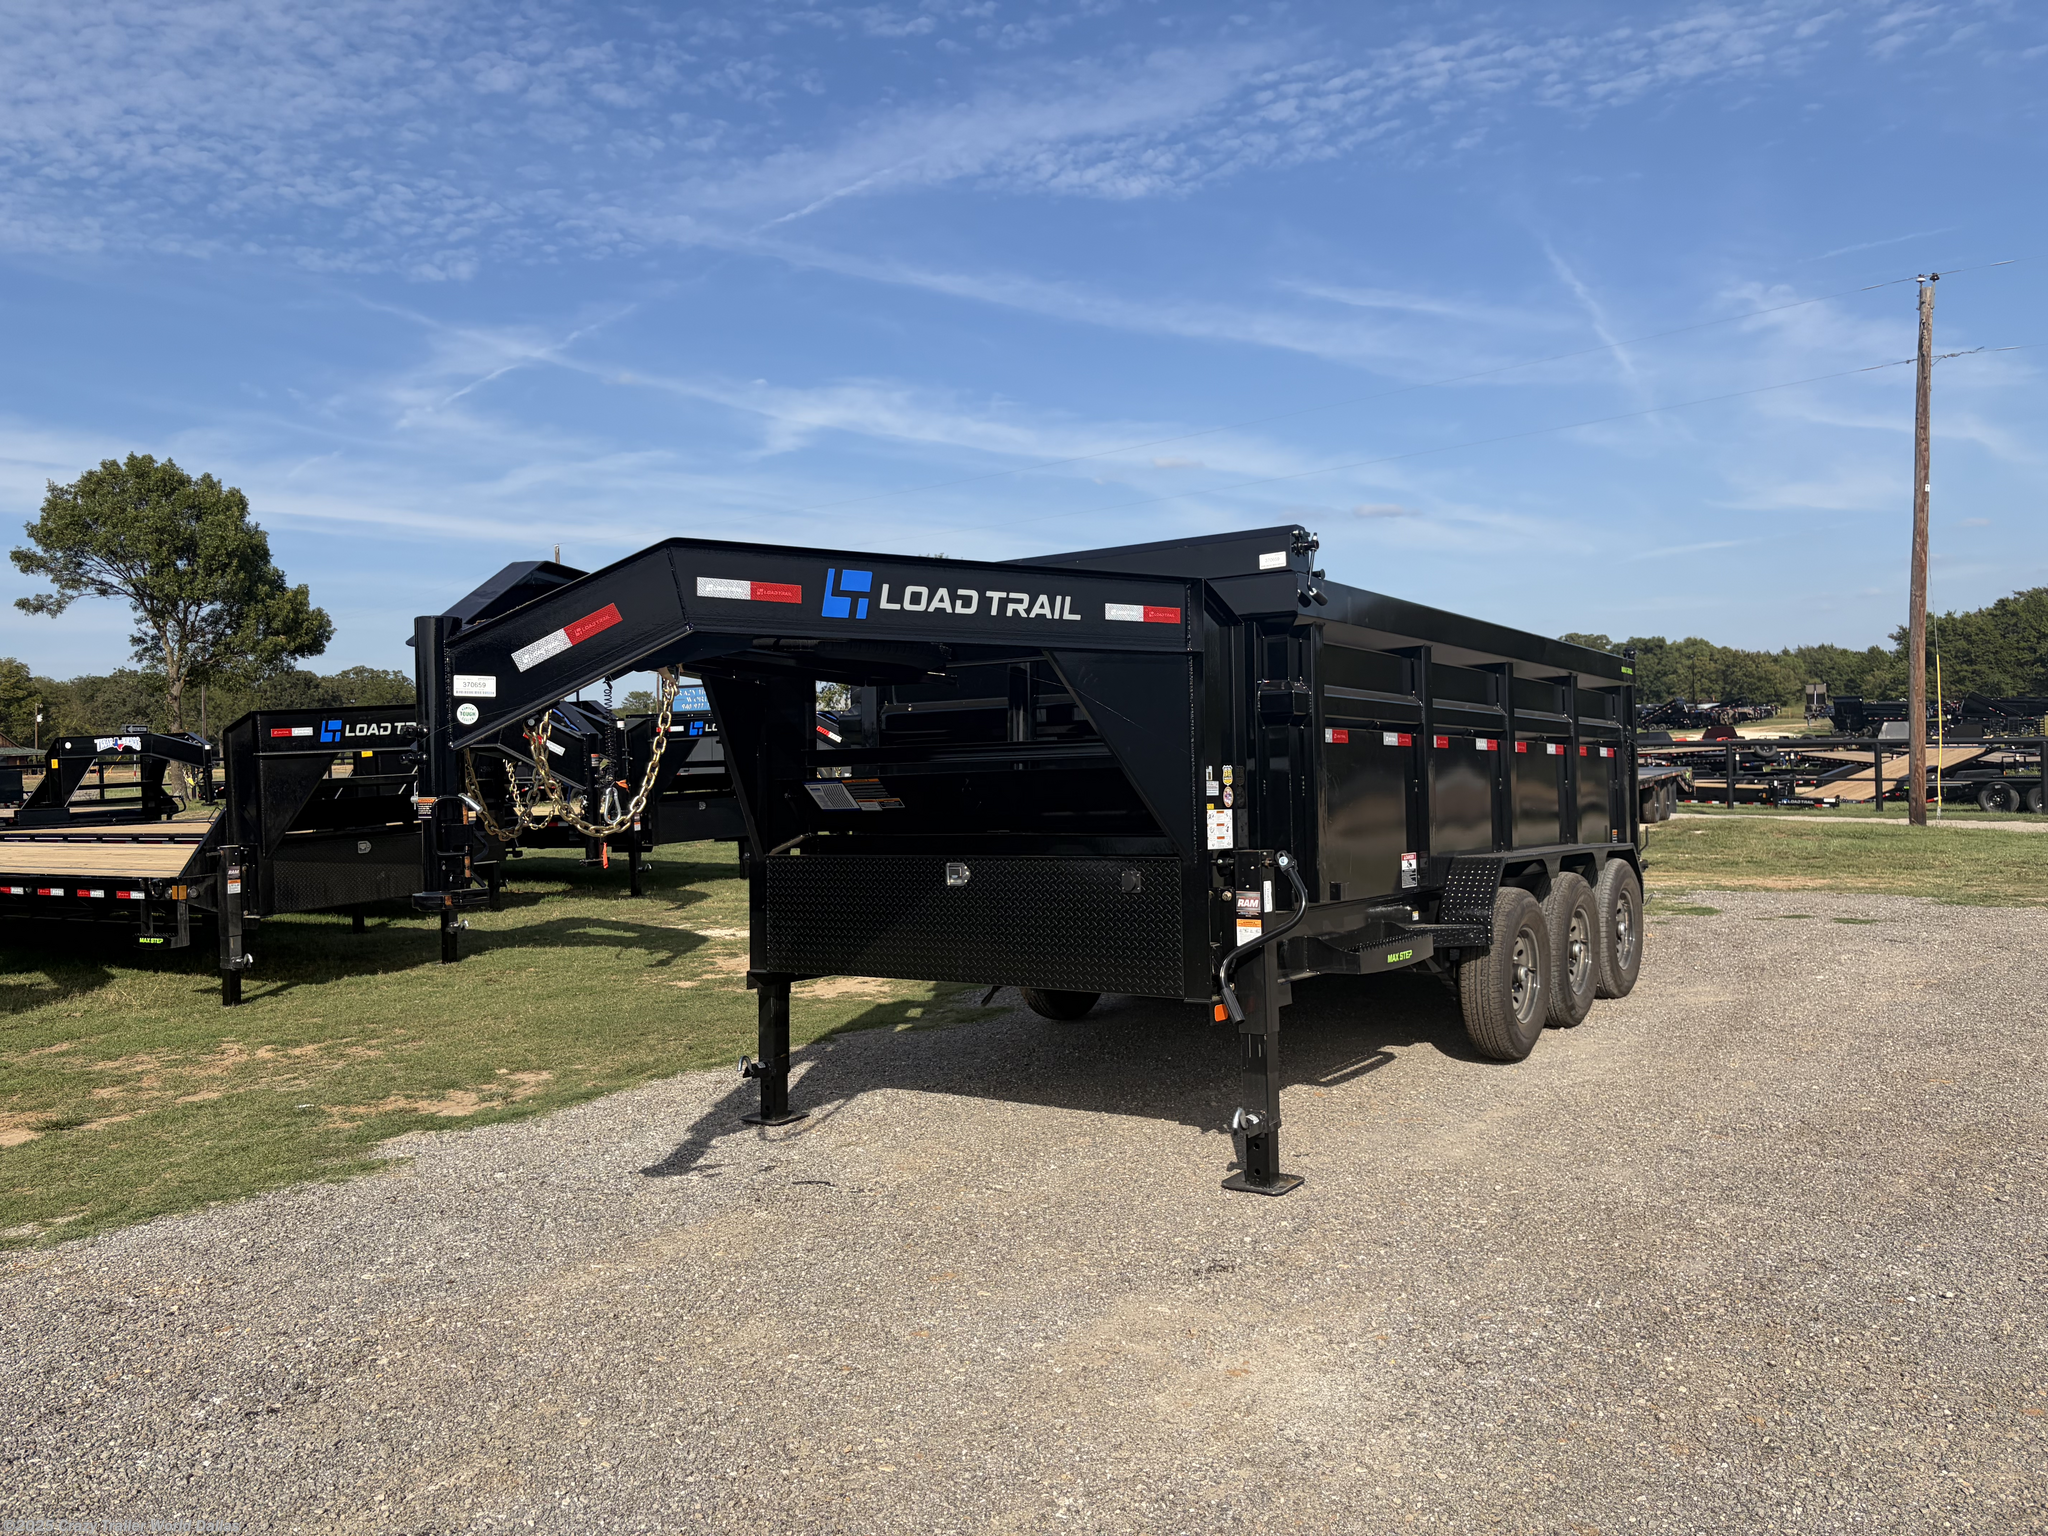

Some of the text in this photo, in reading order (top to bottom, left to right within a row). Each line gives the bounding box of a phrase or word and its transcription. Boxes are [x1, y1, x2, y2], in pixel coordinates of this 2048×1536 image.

[879, 583, 1081, 622] LOAD TRAIL
[345, 723, 392, 737] LOAD
[1237, 899, 1259, 908] RAM
[1387, 949, 1413, 963] MAX STEP
